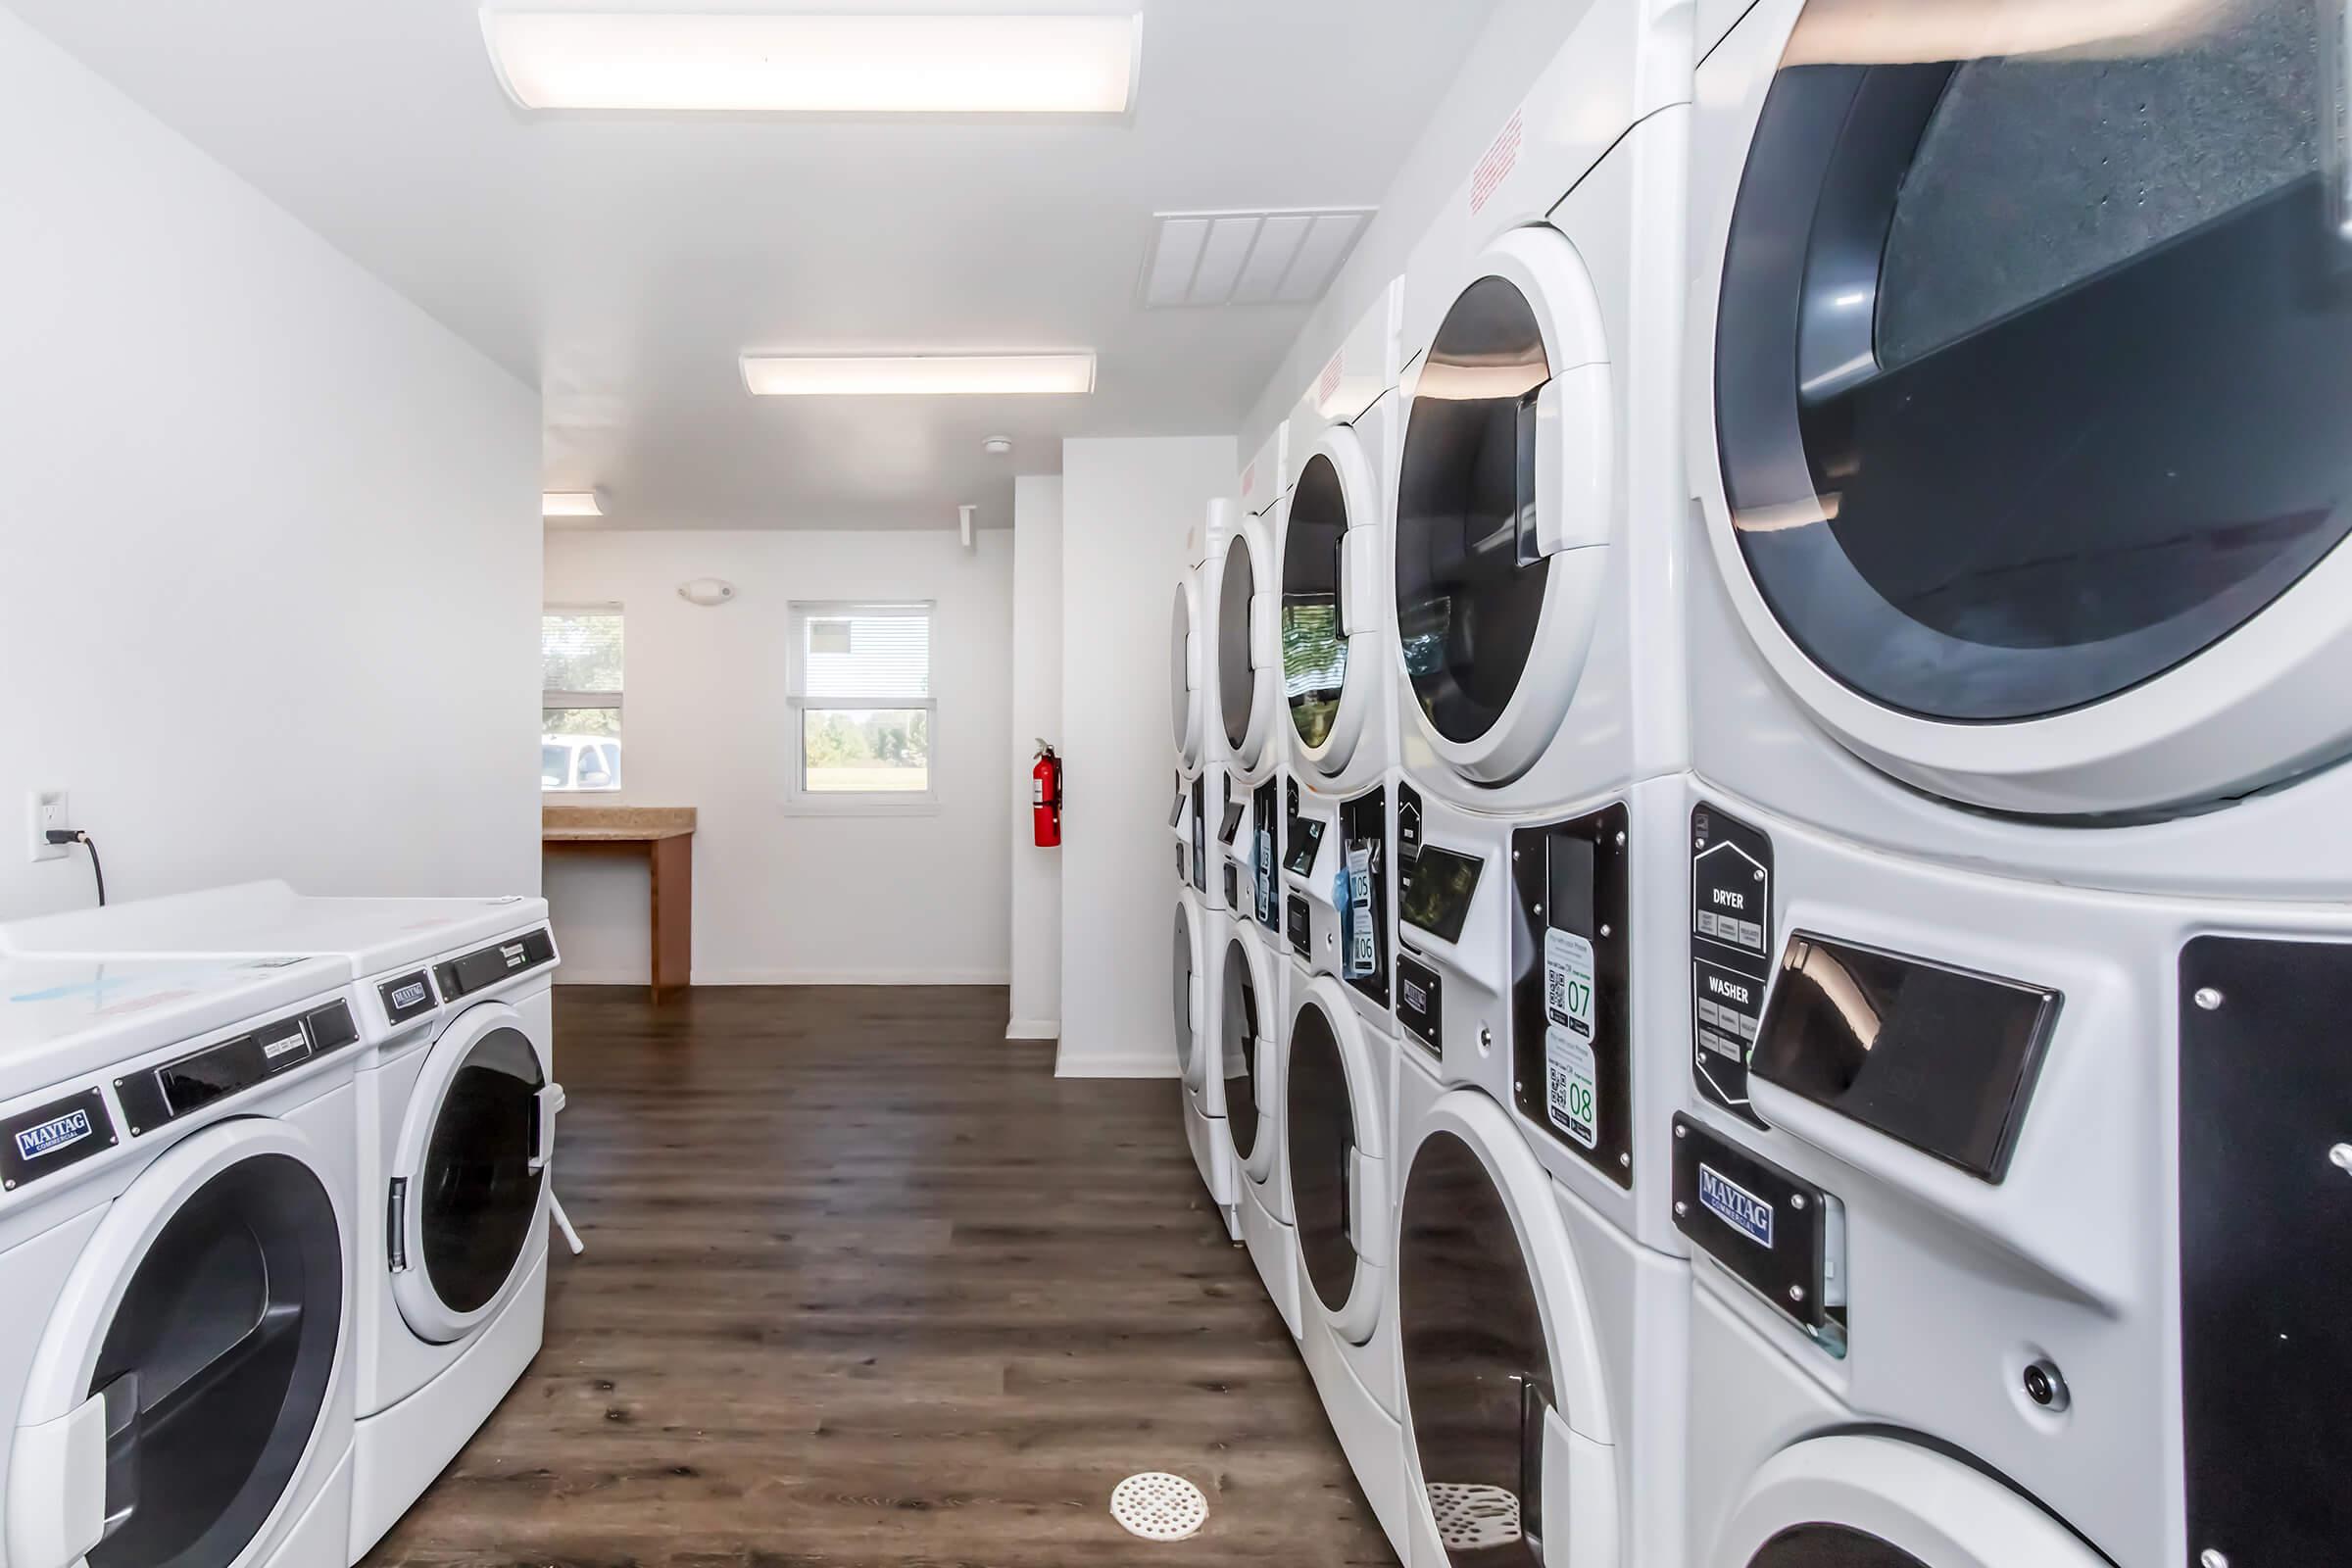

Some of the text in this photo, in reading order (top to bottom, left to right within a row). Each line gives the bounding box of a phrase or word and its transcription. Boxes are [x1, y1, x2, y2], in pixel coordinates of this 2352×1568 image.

[1357, 875, 1368, 897] 05
[1713, 887, 1744, 909] DRYER
[1360, 938, 1372, 958] 06
[1568, 980, 1591, 1017] 07
[1708, 975, 1749, 1004] WASHER
[1570, 1083, 1592, 1123] 08
[22, 1113, 86, 1150] MAYTAG
[1703, 1171, 1768, 1231] MAYTAG
